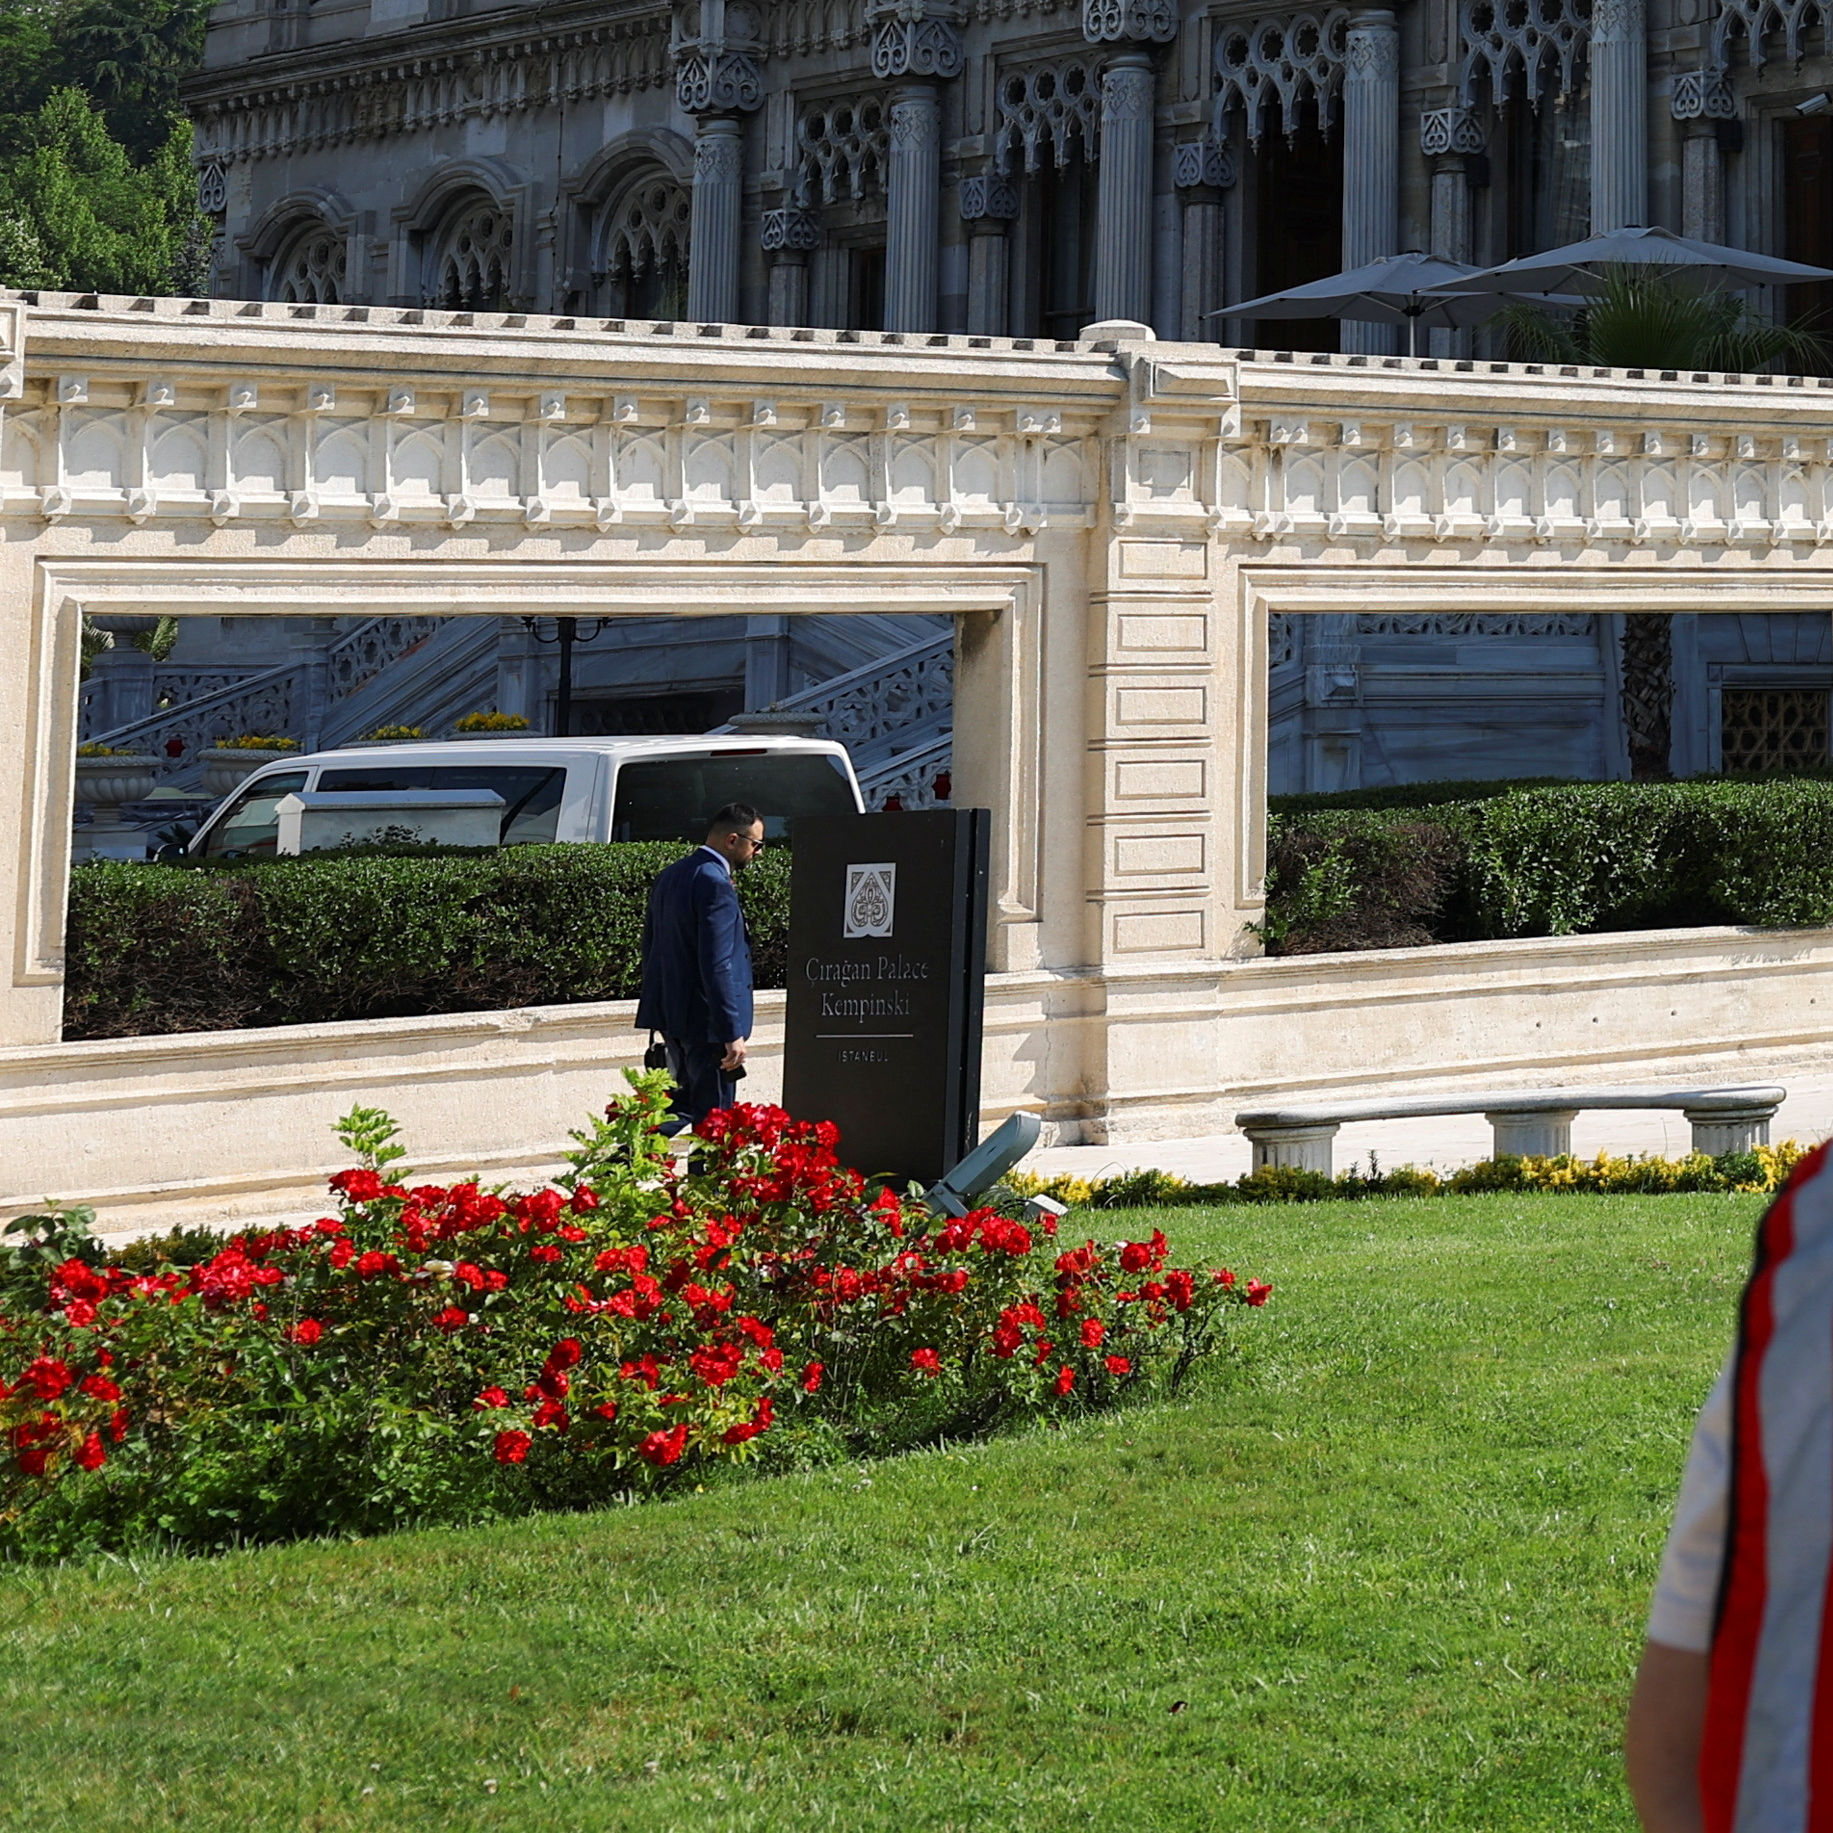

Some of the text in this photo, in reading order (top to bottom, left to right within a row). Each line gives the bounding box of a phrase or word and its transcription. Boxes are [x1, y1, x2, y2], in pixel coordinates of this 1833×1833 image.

[805, 953, 929, 987] Çırağan Palace
[821, 989, 910, 1023] Kempinski
